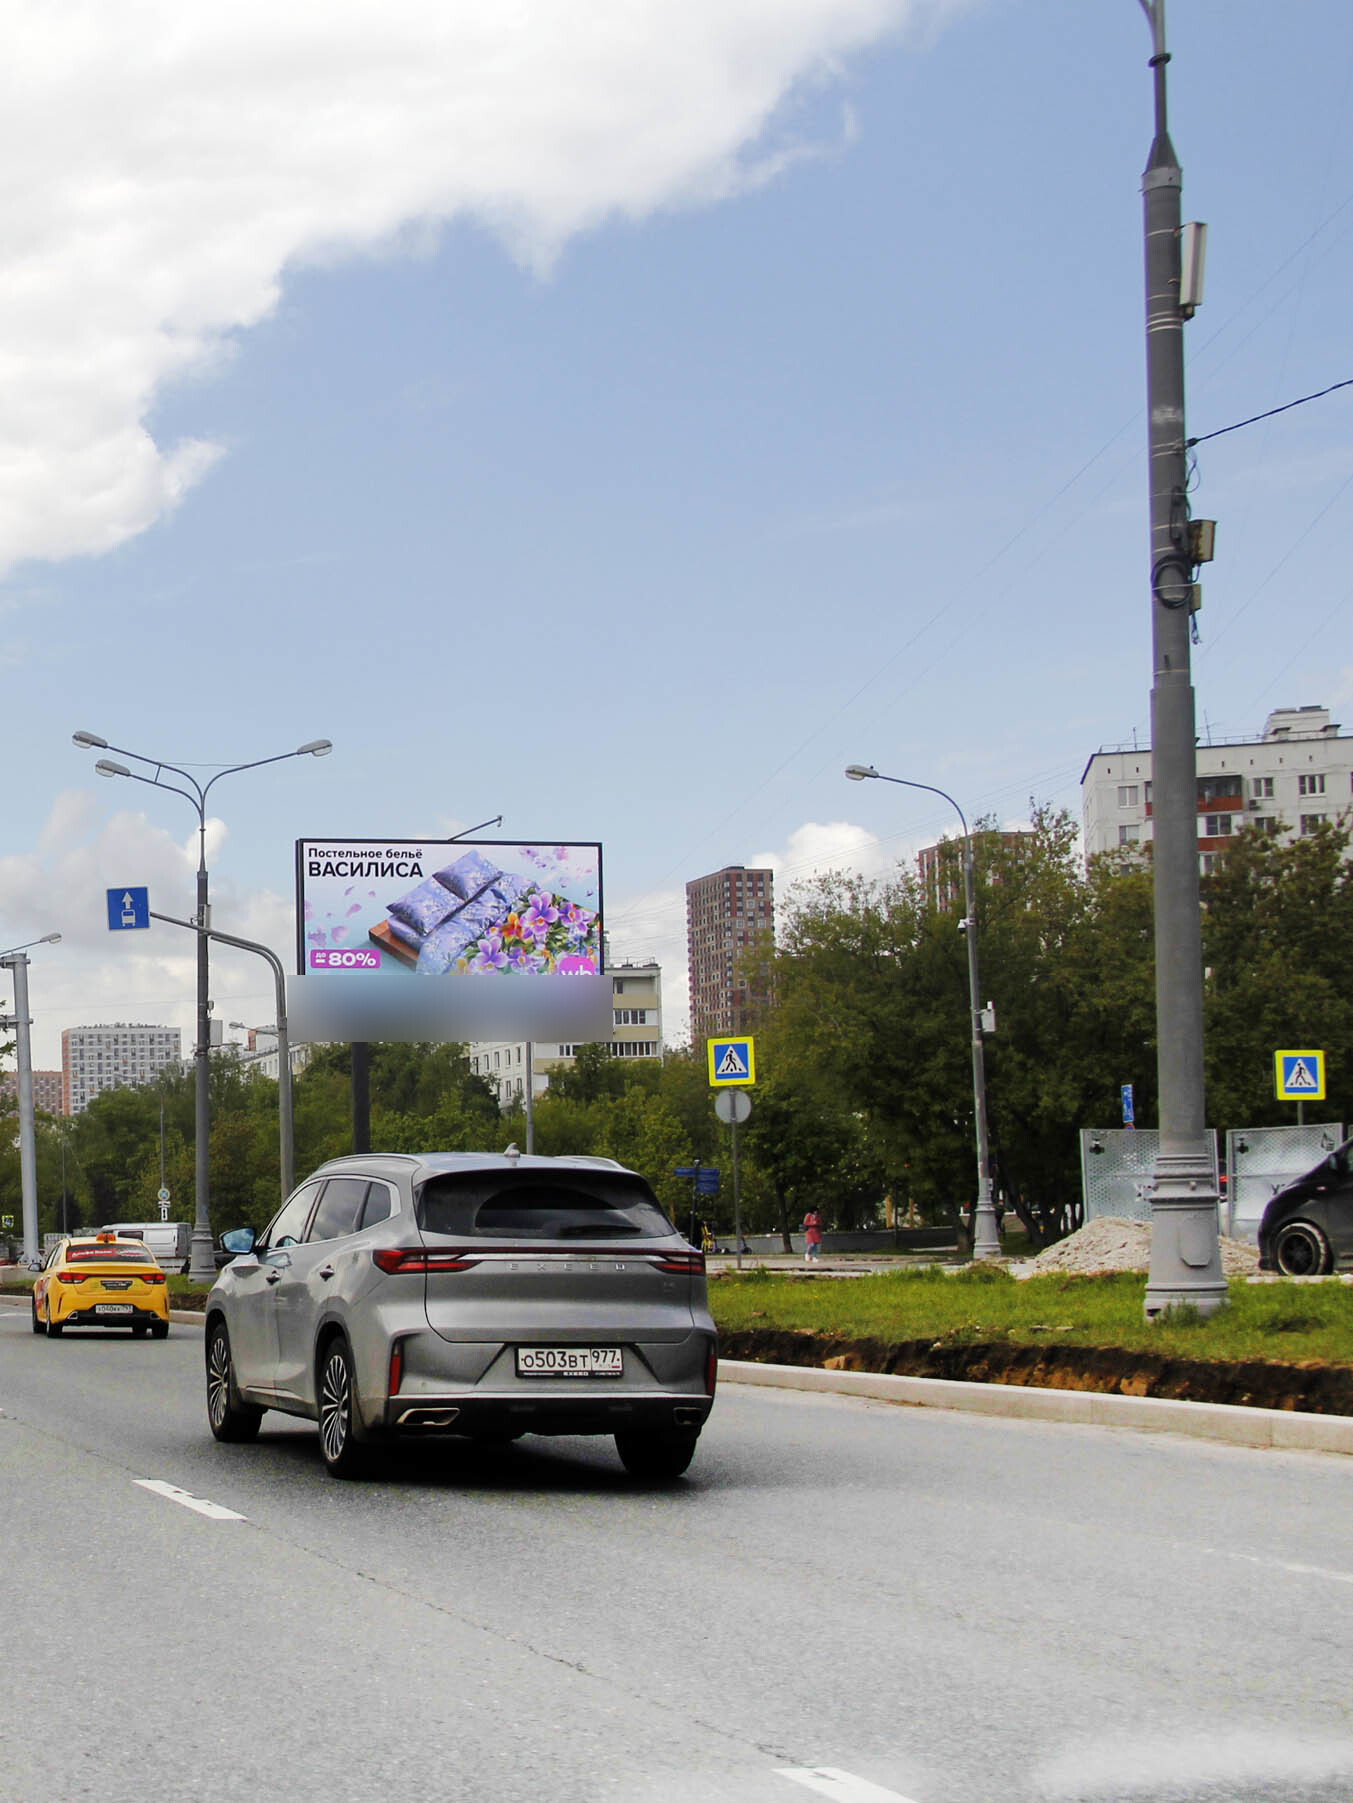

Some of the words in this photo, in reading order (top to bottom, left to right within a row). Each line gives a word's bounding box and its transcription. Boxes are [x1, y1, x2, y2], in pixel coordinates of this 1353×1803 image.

[308, 848, 382, 858] Постельное
[386, 849, 423, 859] бельё
[308, 862, 423, 878] ВАСИЛИСА
[510, 1263, 625, 1272] EXEED
[524, 1351, 588, 1368] О503ВТ
[592, 1350, 617, 1363] 977
